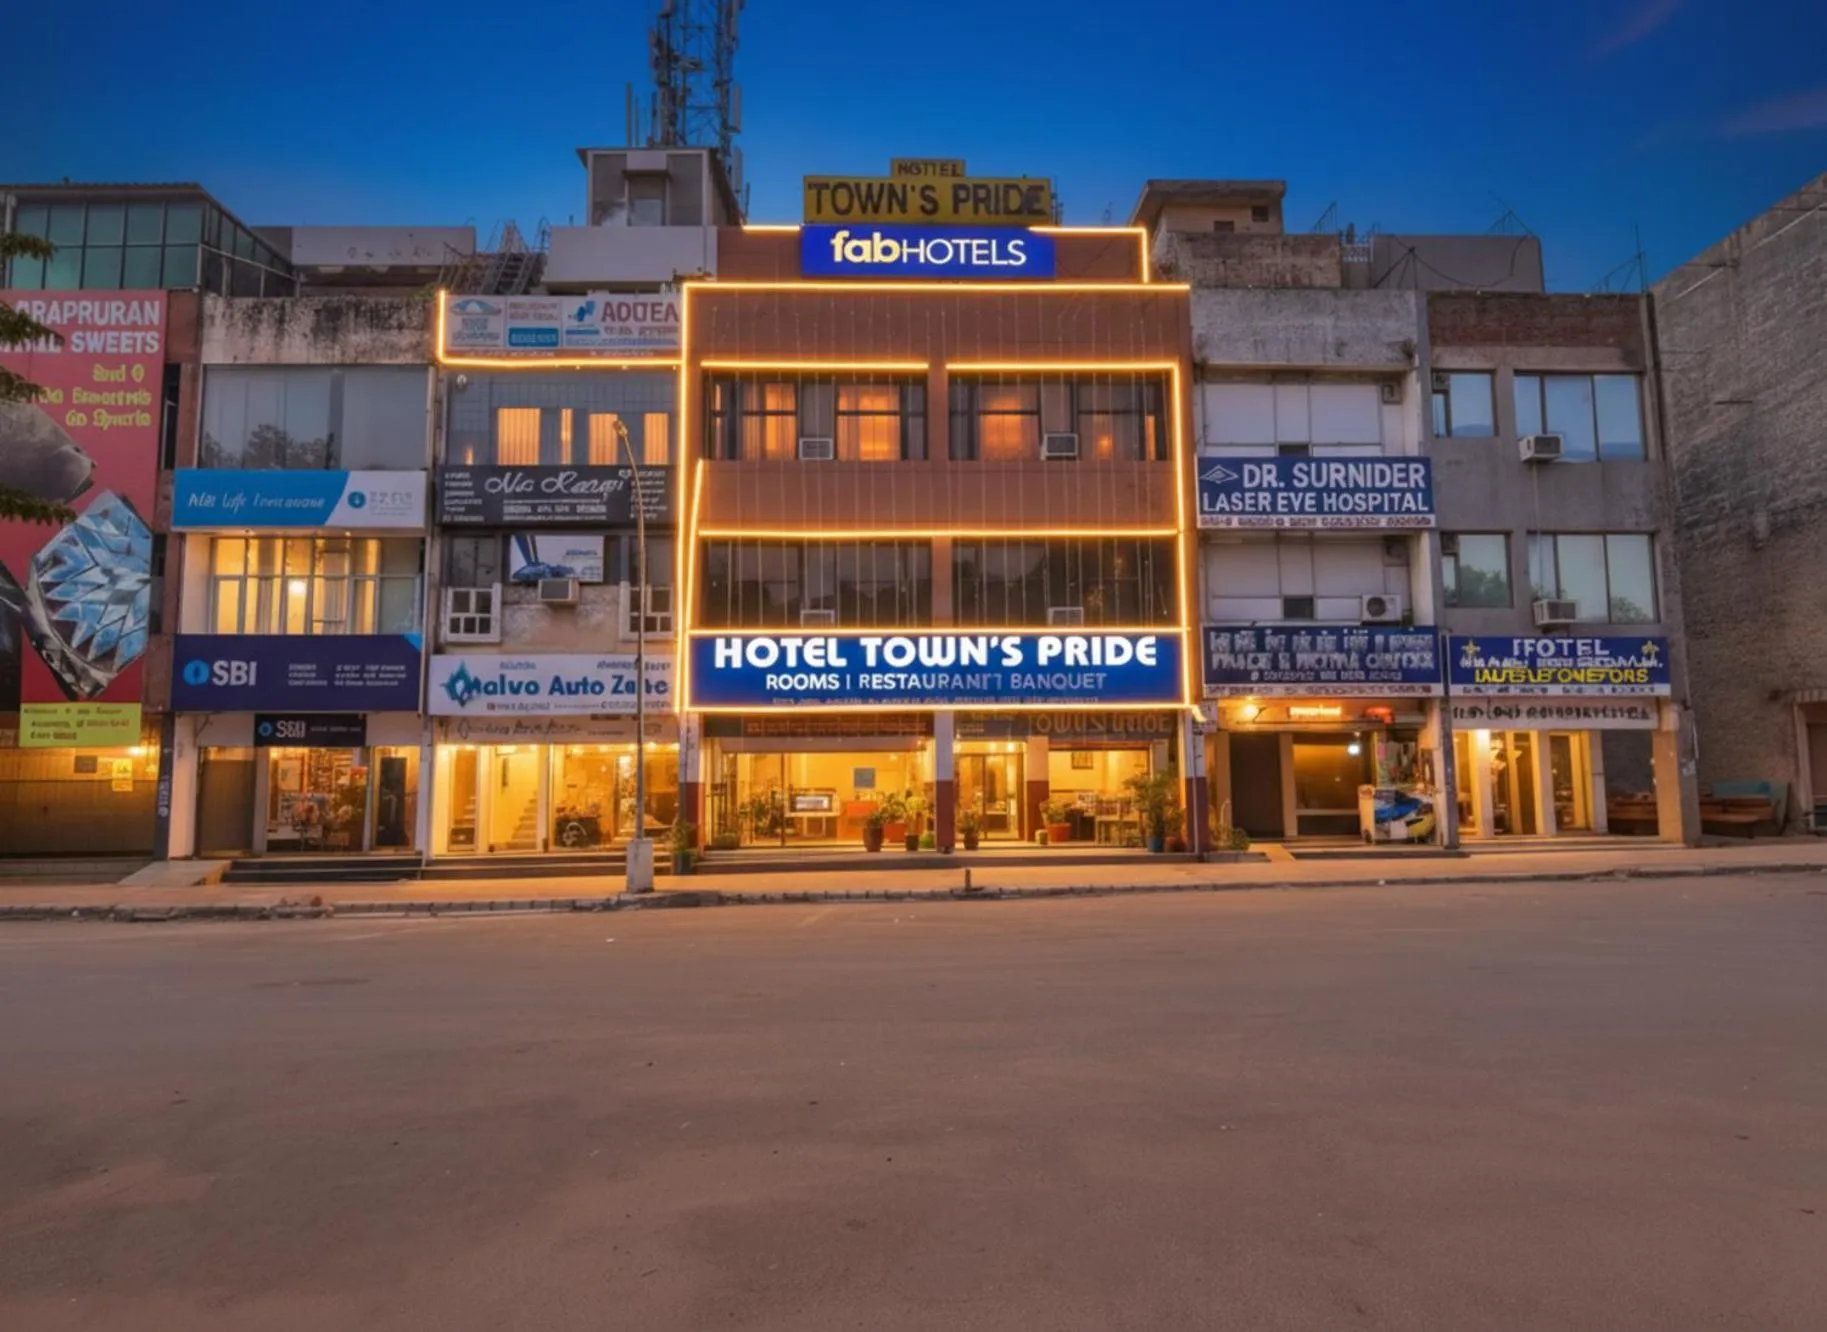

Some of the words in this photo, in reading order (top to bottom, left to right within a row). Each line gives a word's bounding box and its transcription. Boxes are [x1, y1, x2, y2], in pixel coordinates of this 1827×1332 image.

[808, 183, 939, 216] TOWN'S
[952, 184, 1047, 216] PRIDE
[830, 230, 1027, 266] fabHOTELS
[71, 331, 160, 354] SWEETS
[1242, 463, 1285, 489] DR.
[1292, 463, 1426, 489] SURNIDER
[1202, 492, 1272, 513] LASER
[1322, 492, 1429, 513] HOSPITAL
[714, 637, 846, 667] HOTEL
[858, 635, 1023, 667] TOWN'S
[1036, 636, 1157, 665] PRIDE
[212, 661, 257, 686] SBI
[548, 675, 605, 697] Auto
[766, 674, 840, 690] ROOMS
[1010, 674, 1107, 690] BANQUET
